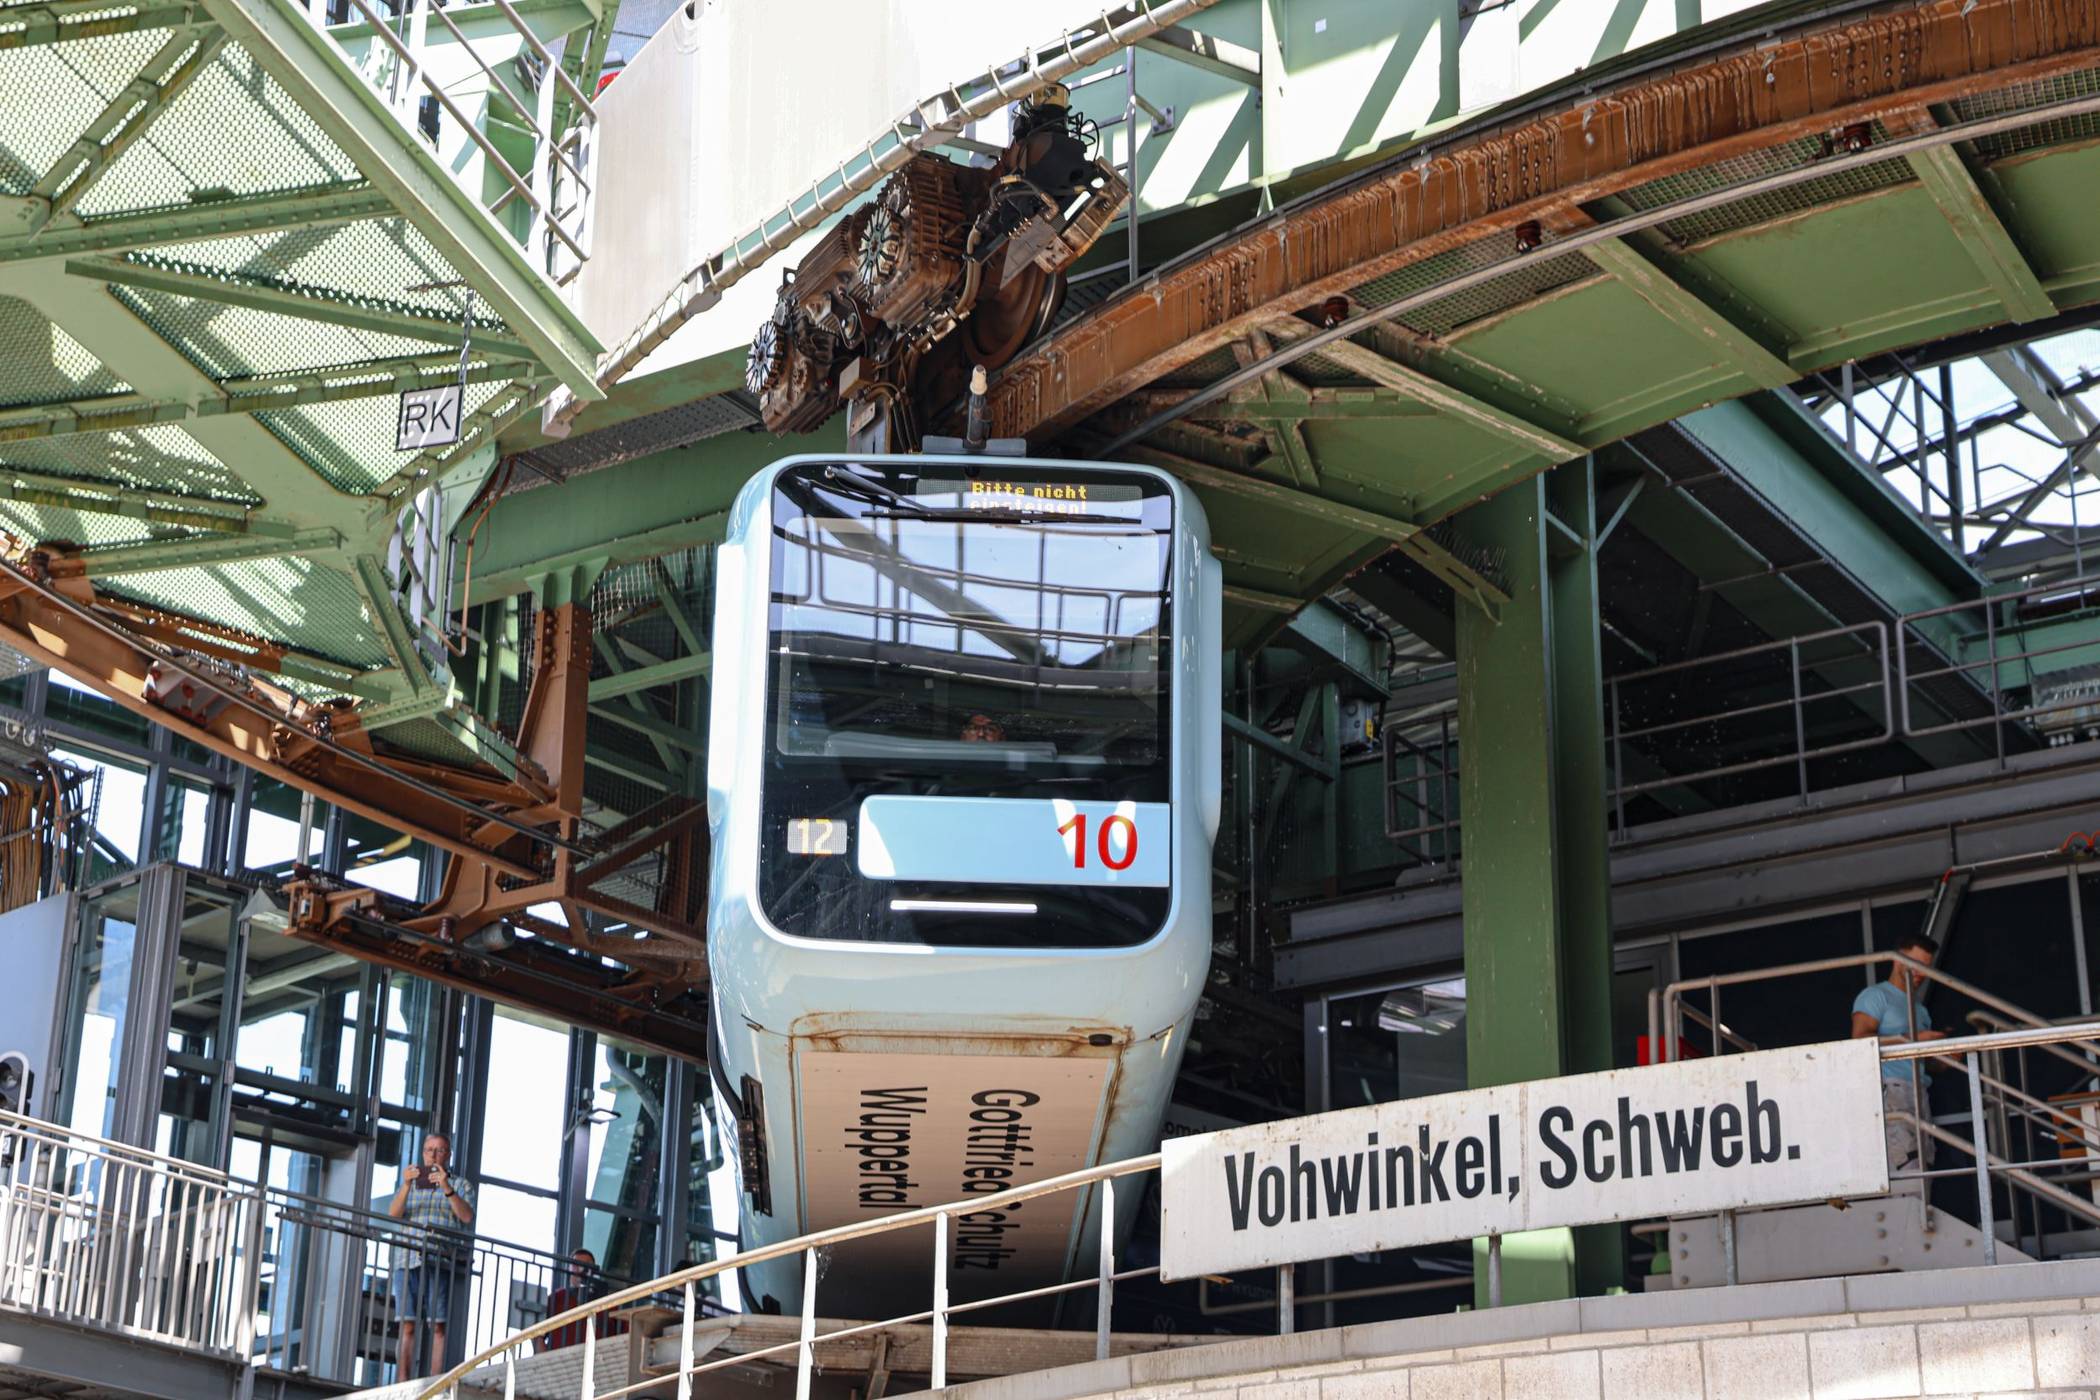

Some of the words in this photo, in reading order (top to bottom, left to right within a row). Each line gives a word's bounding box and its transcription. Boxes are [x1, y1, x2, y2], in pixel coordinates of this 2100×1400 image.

[404, 398, 453, 436] RK
[972, 481, 1025, 497] Bitte
[1034, 485, 1087, 500] nicht
[798, 817, 833, 857] 12
[1057, 813, 1138, 871] 10
[844, 1087, 928, 1208] Wuppertal
[1224, 1114, 1520, 1231] Vohwinkel,
[1539, 1080, 1801, 1189] Schweb.
[953, 1201, 1023, 1270] chultz
